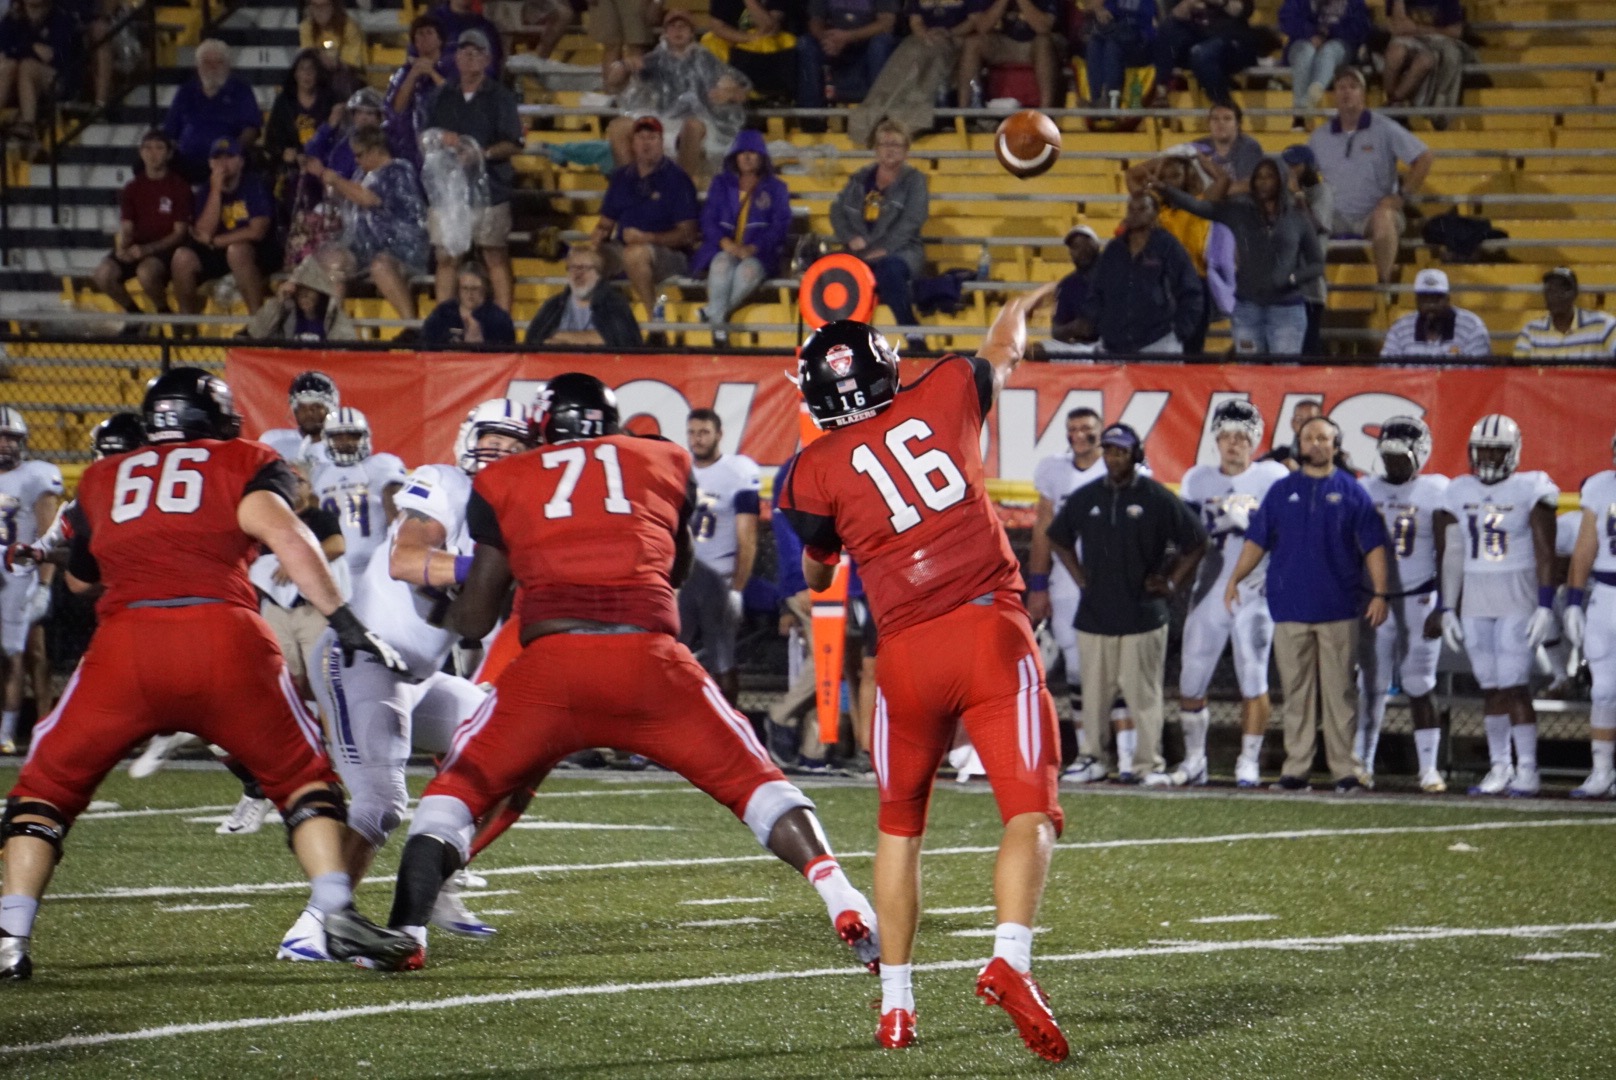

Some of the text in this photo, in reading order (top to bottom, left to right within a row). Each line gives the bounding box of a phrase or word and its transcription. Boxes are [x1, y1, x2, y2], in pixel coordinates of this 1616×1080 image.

[840, 391, 866, 410] 16
[153, 411, 179, 428] 66
[580, 420, 604, 435] 71
[835, 410, 877, 426] BLAZERS
[541, 443, 632, 519] 71
[851, 417, 968, 534] 16
[110, 447, 211, 524] 66
